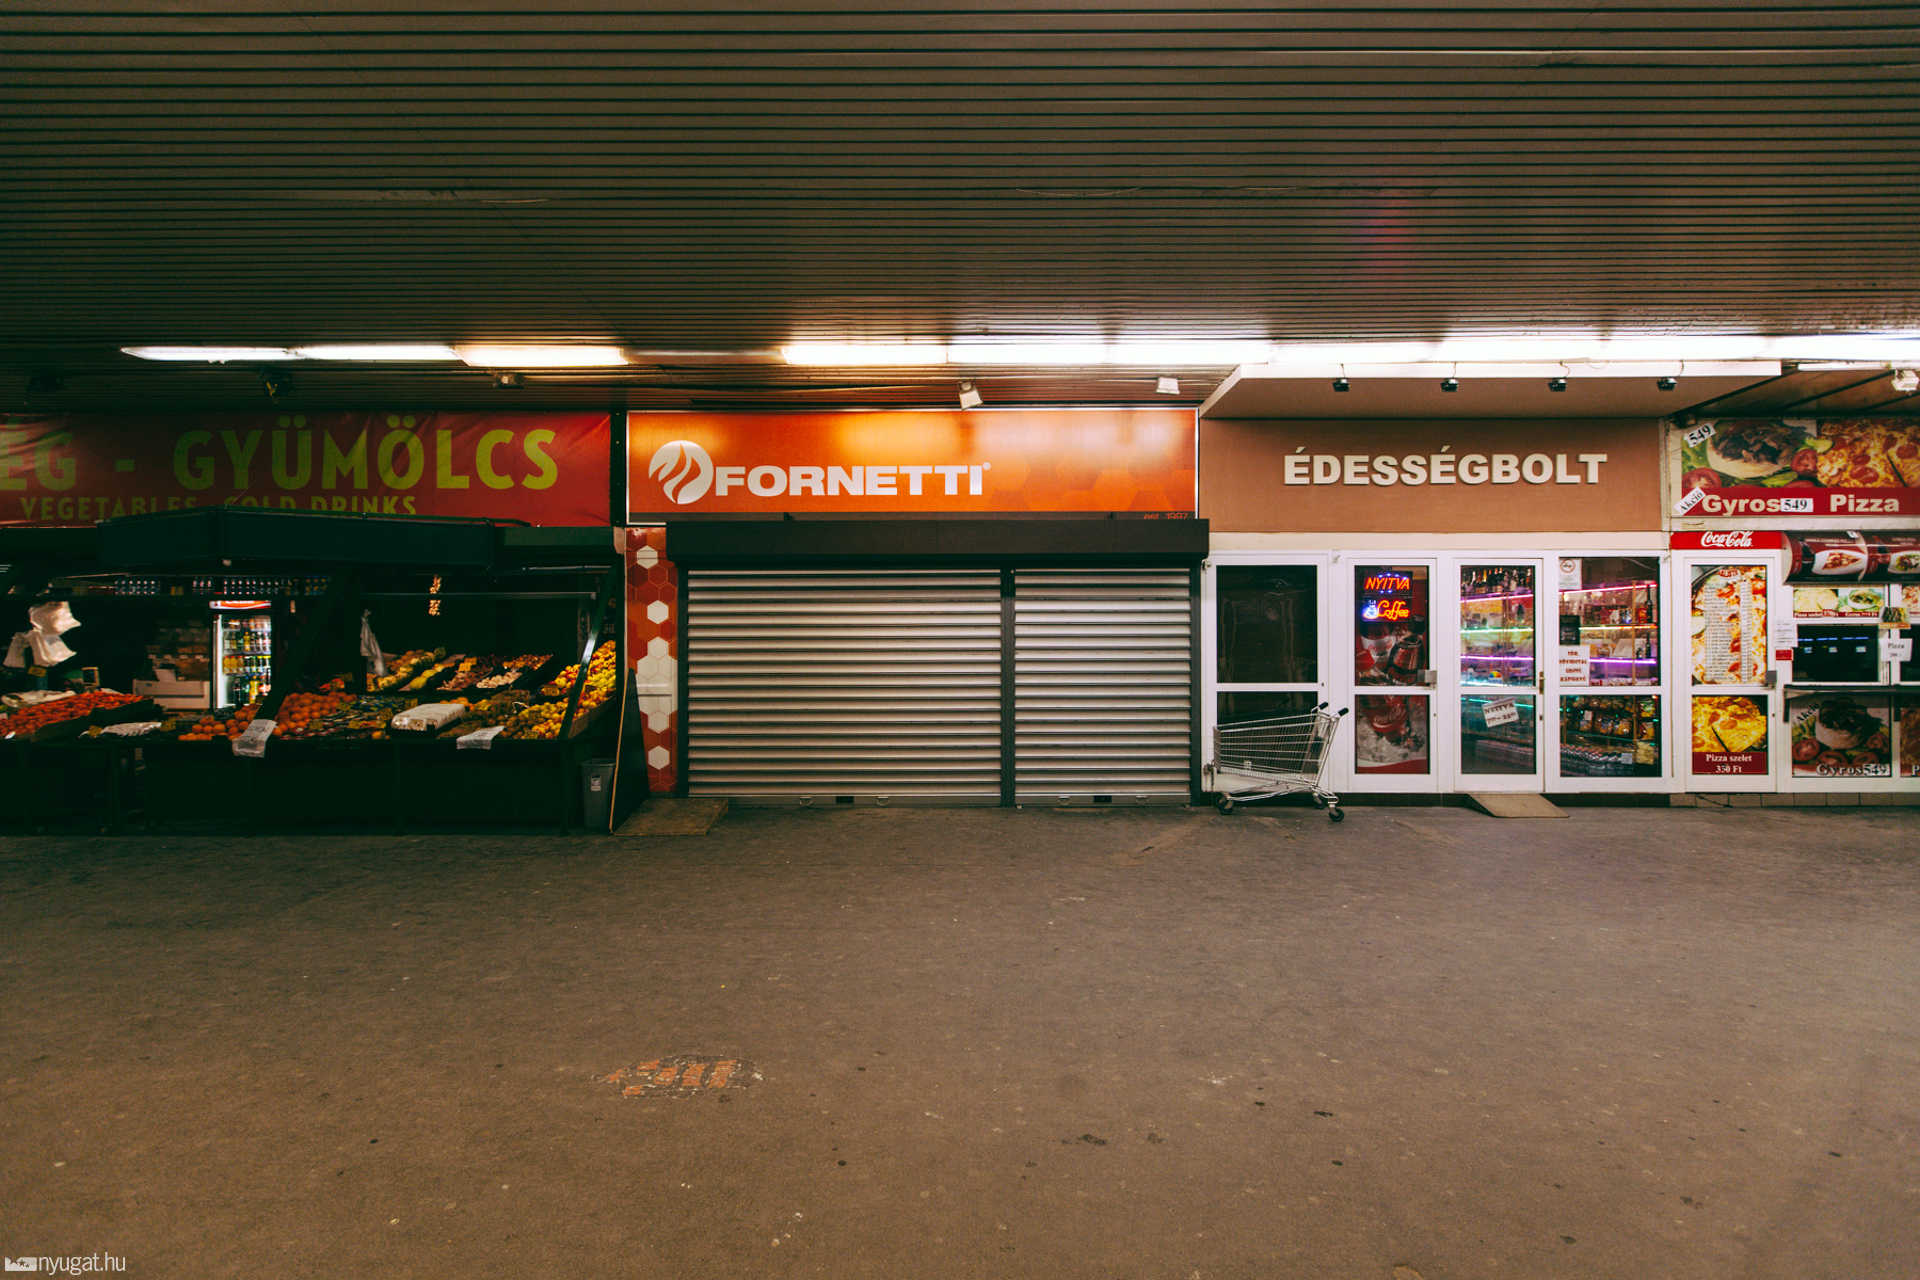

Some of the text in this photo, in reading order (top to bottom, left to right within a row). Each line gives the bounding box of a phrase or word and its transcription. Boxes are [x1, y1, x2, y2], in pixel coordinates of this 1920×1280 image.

[1687, 422, 1713, 445] 549
[172, 414, 558, 492] GYÜMÖLCS
[1283, 445, 1608, 486] ÉDESSÉGBOLT
[714, 464, 983, 497] FORNETTI
[1680, 489, 1705, 514] Akció
[1702, 494, 1781, 516] Gyros
[1783, 499, 1808, 511] 549
[1829, 494, 1900, 513] Pizza
[1364, 576, 1411, 592] NYITVA
[1376, 599, 1410, 622] Coffee
[1705, 753, 1752, 762] Pizza szelet
[1816, 763, 1863, 777] Gyros
